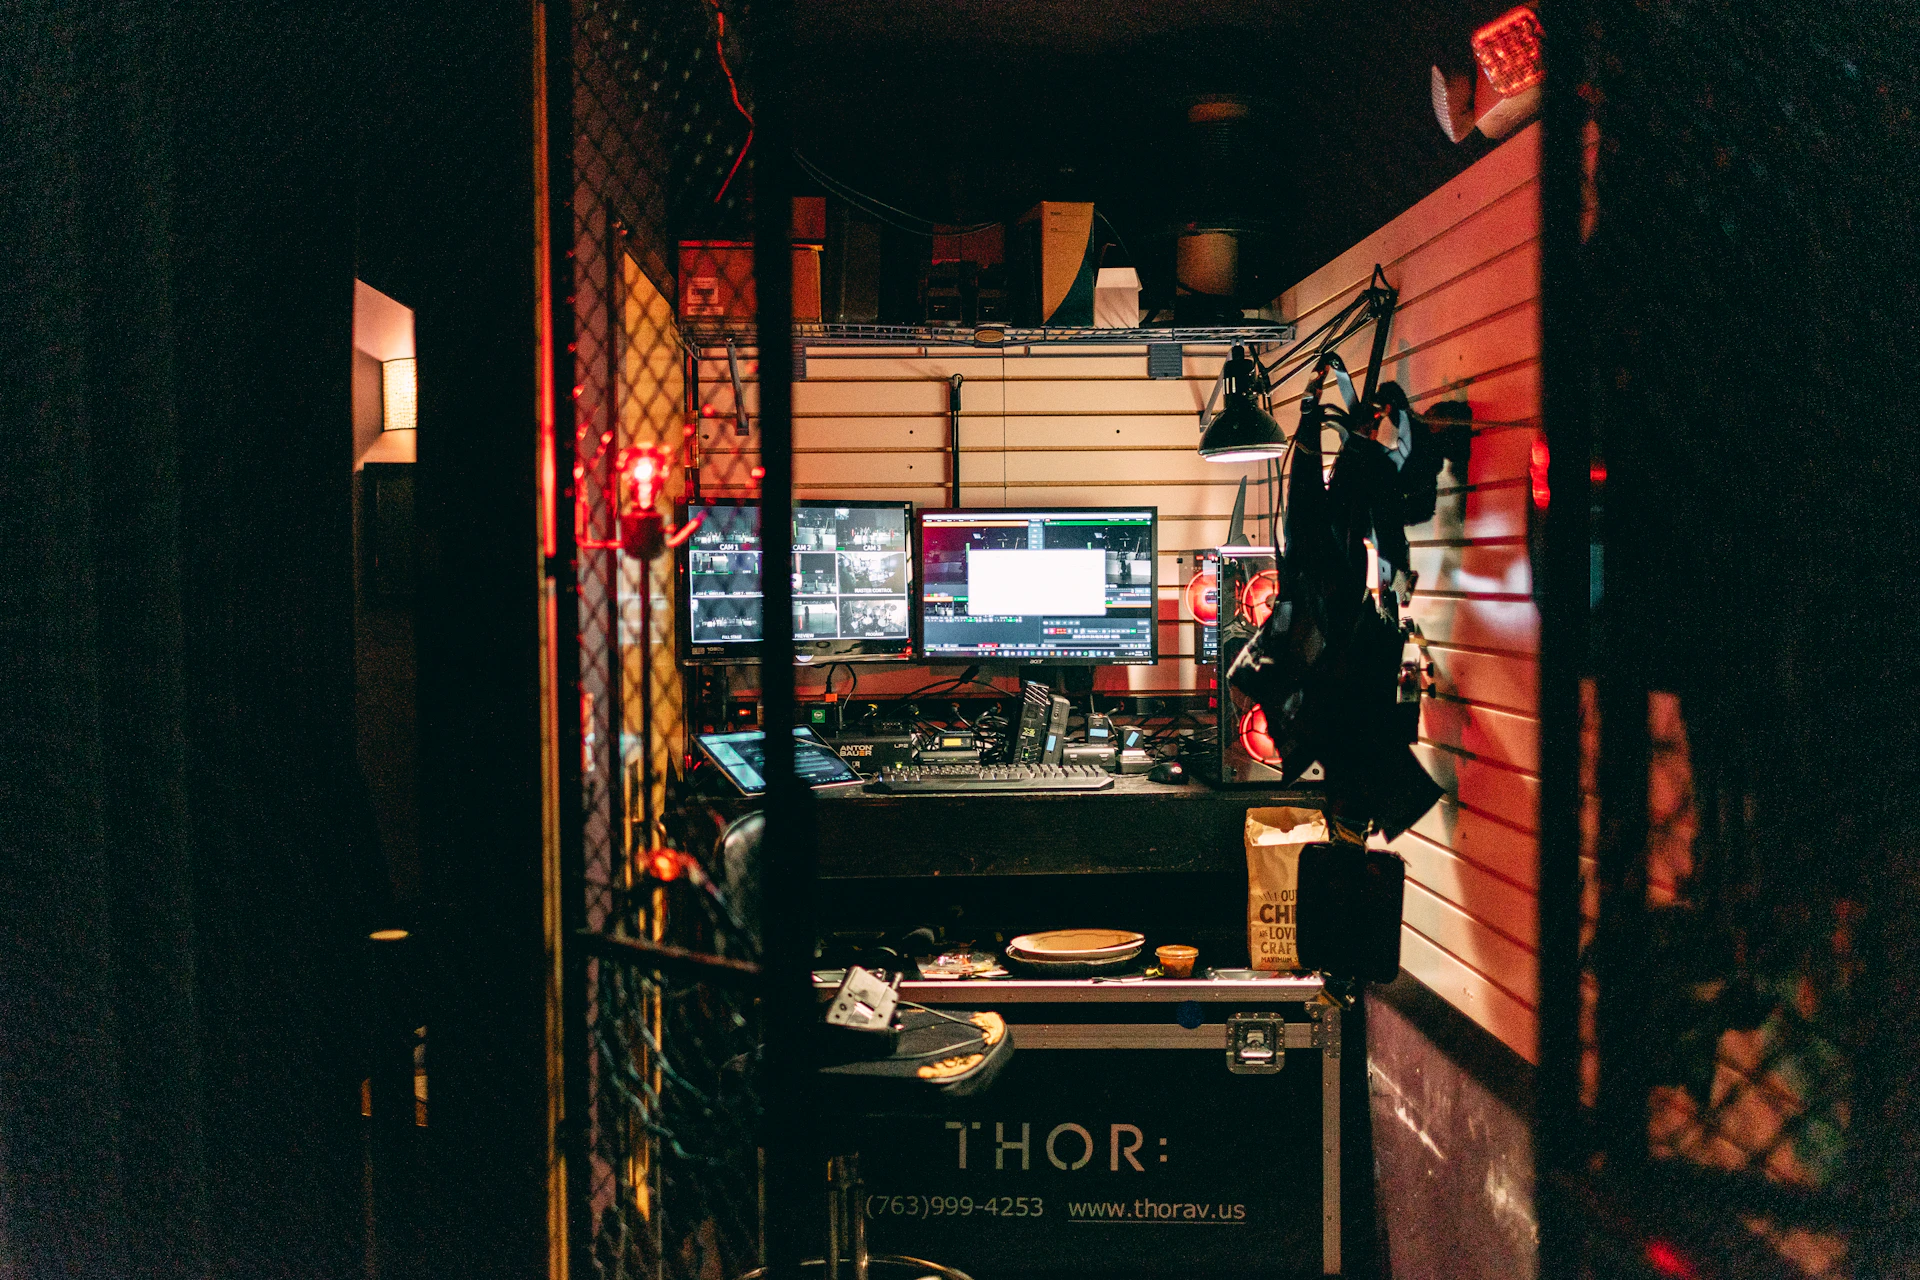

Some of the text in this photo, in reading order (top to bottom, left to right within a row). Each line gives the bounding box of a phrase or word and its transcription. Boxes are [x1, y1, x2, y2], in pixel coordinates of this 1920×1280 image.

[1281, 890, 1298, 901] OU
[866, 1196, 1247, 1220] (763)999-4253 www.thorav.us
